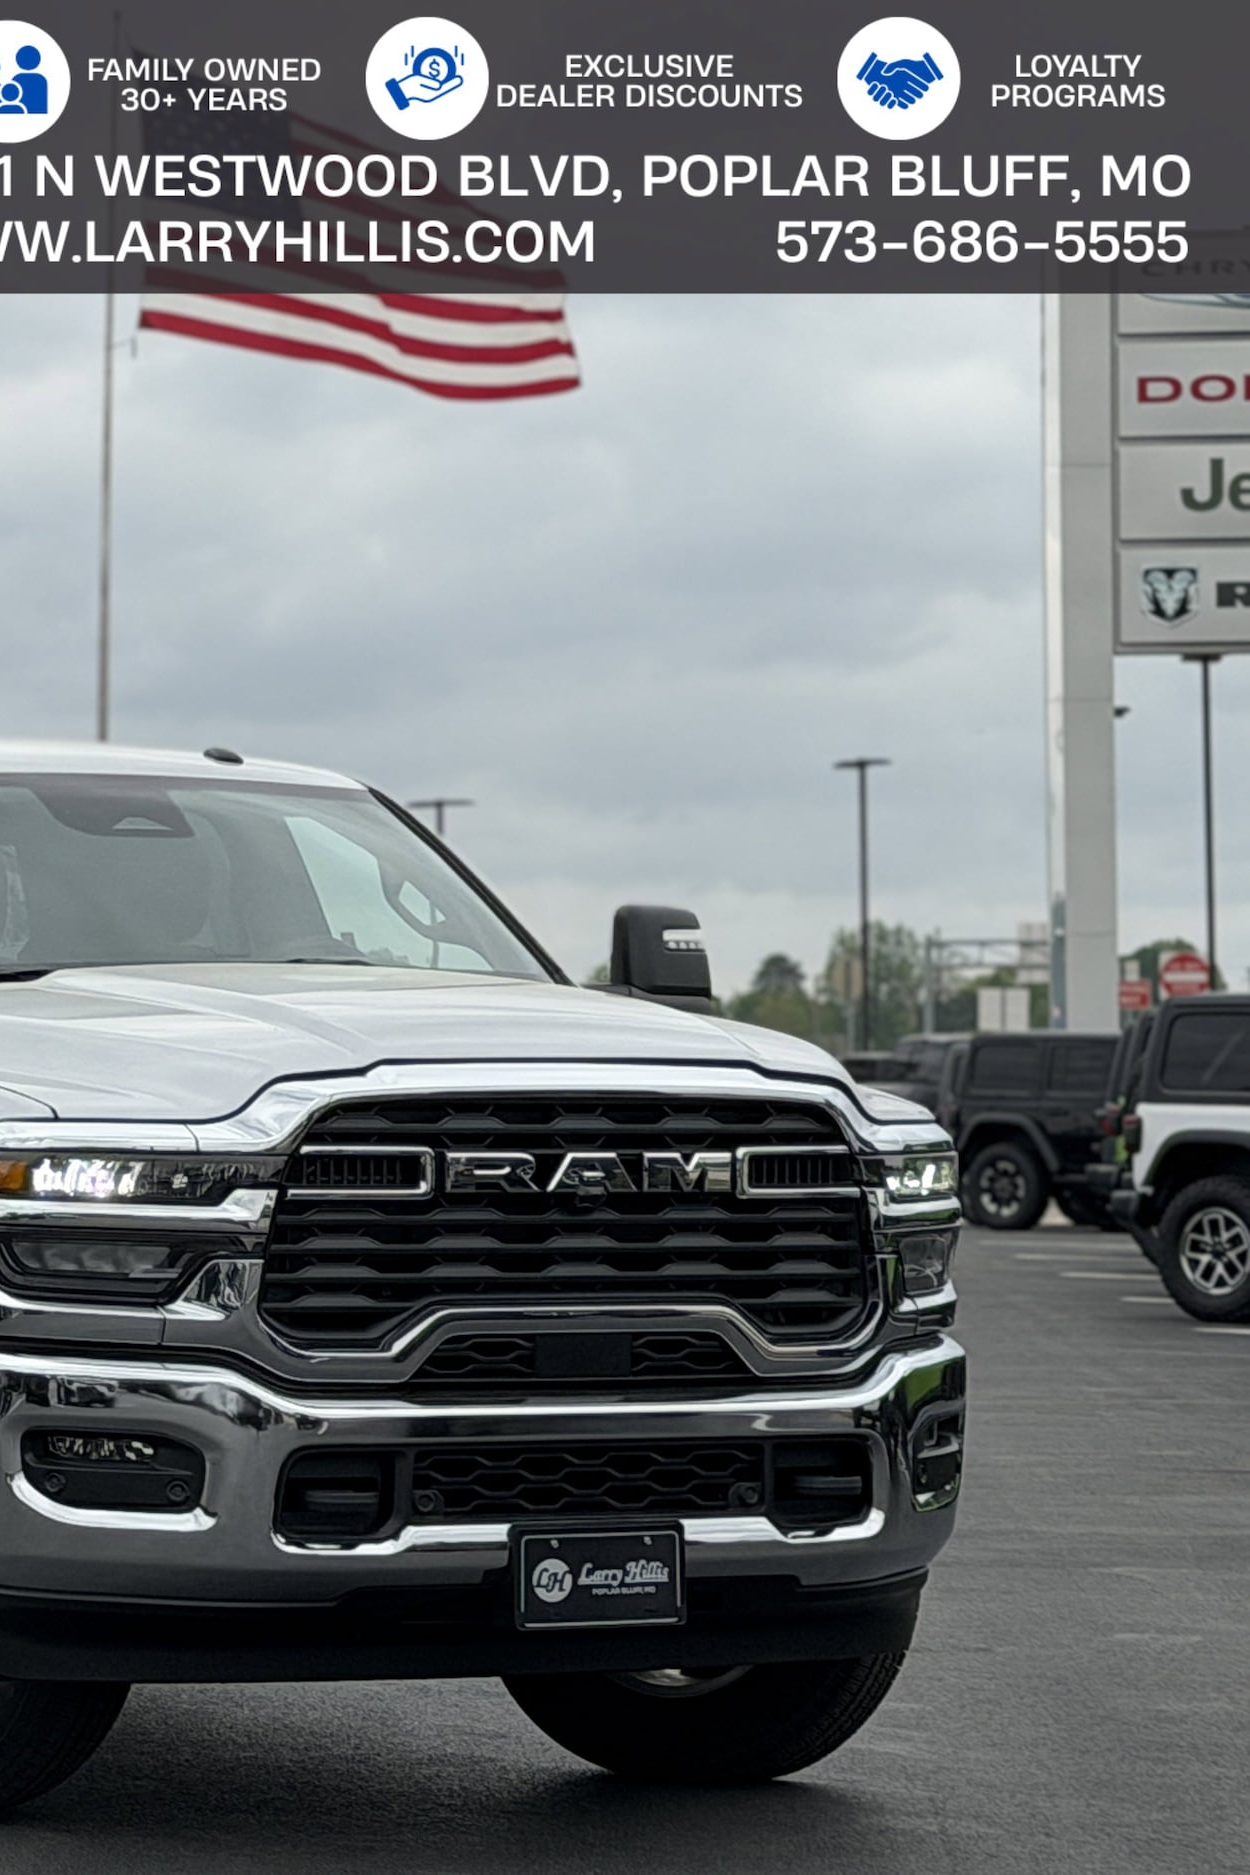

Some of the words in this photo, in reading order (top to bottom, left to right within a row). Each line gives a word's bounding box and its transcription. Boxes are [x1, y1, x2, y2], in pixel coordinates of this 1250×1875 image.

[1138, 374, 1250, 404] DO
[445, 1151, 732, 1193] RAM
[577, 1562, 623, 1587] Larry
[624, 1559, 669, 1584] Hillis
